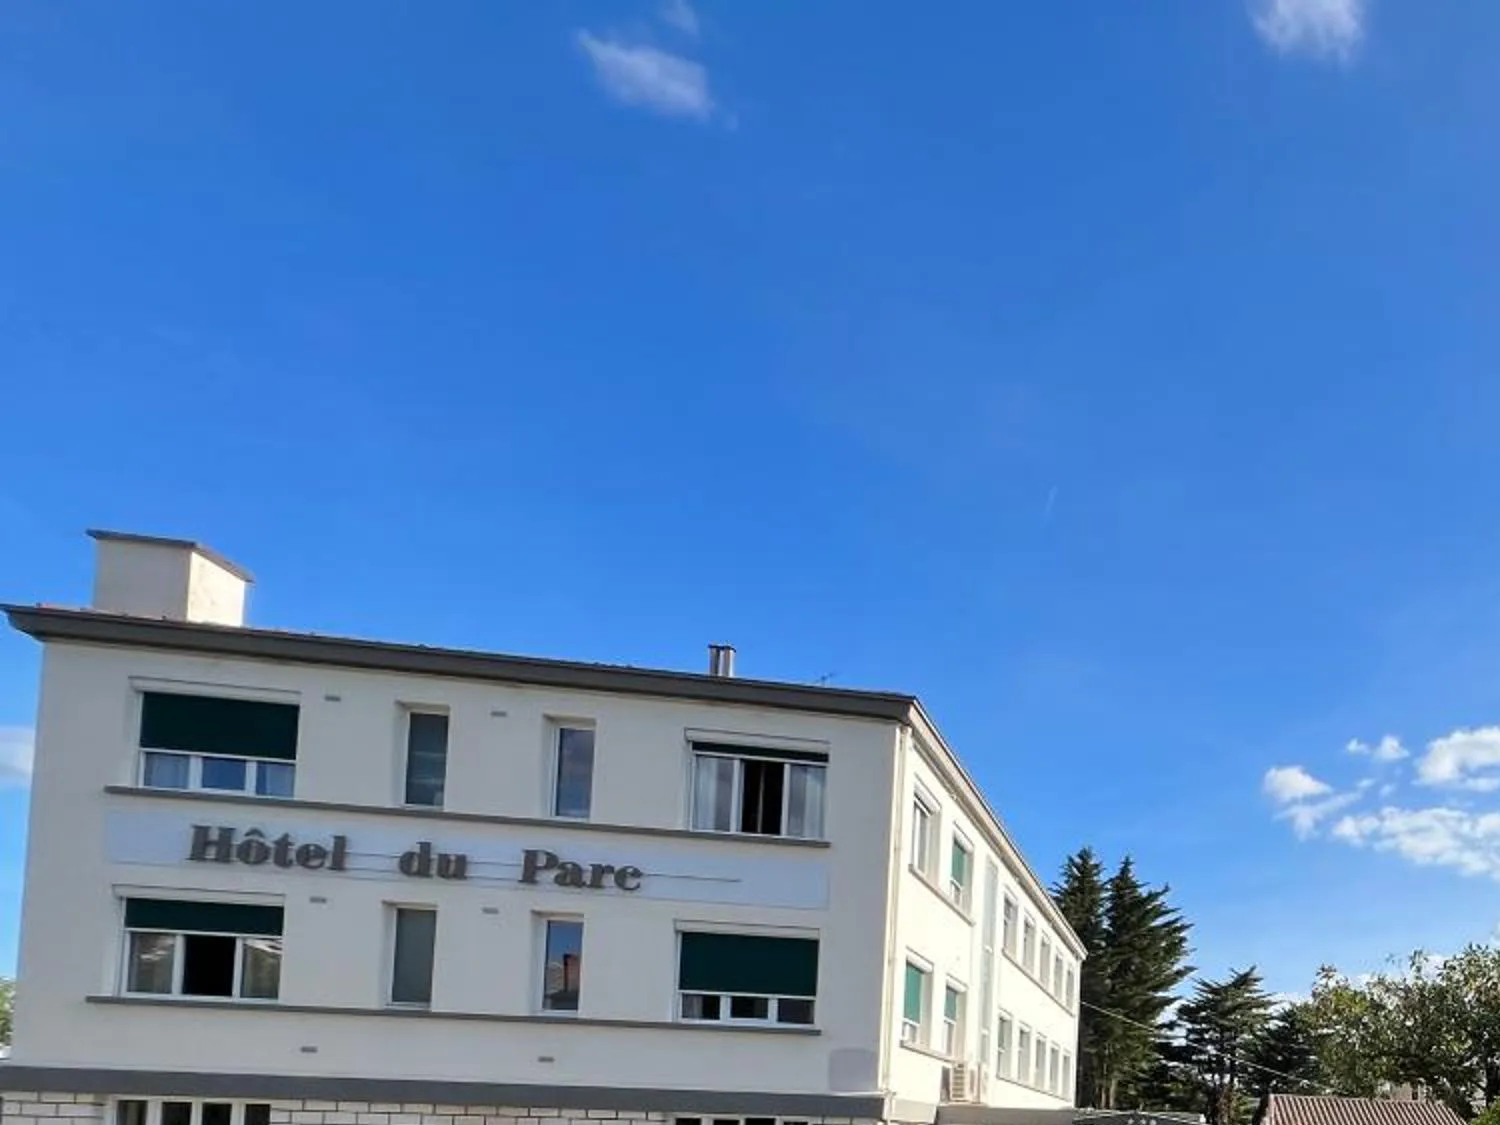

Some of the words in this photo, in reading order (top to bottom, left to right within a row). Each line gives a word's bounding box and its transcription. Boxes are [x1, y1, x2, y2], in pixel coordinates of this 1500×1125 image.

[187, 823, 349, 872] Hôtel
[398, 841, 468, 881] du
[518, 848, 643, 891] Parc
